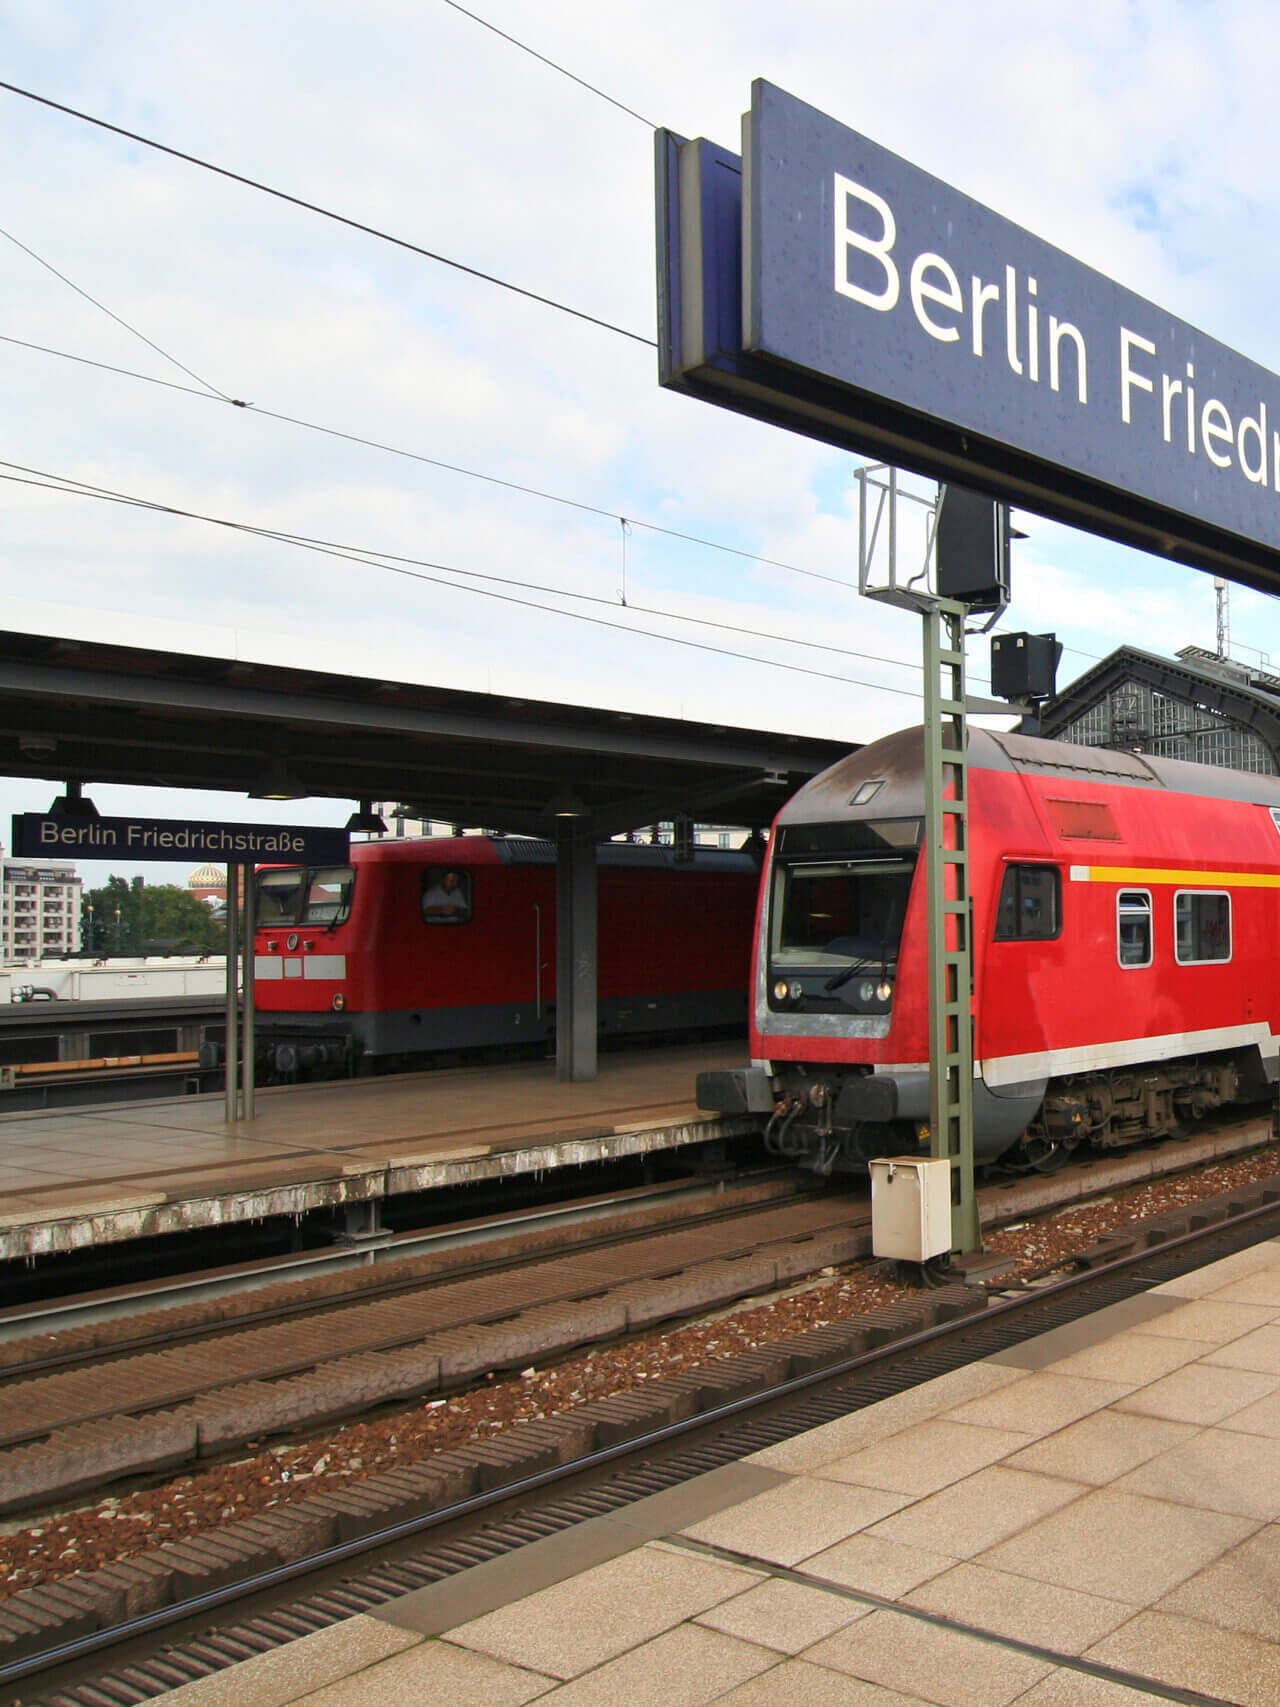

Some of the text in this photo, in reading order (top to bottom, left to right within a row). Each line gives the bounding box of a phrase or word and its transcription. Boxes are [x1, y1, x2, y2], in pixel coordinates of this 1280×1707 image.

[833, 172, 1088, 405] Berlin
[40, 821, 305, 852] Berlin Friedrichstraße
